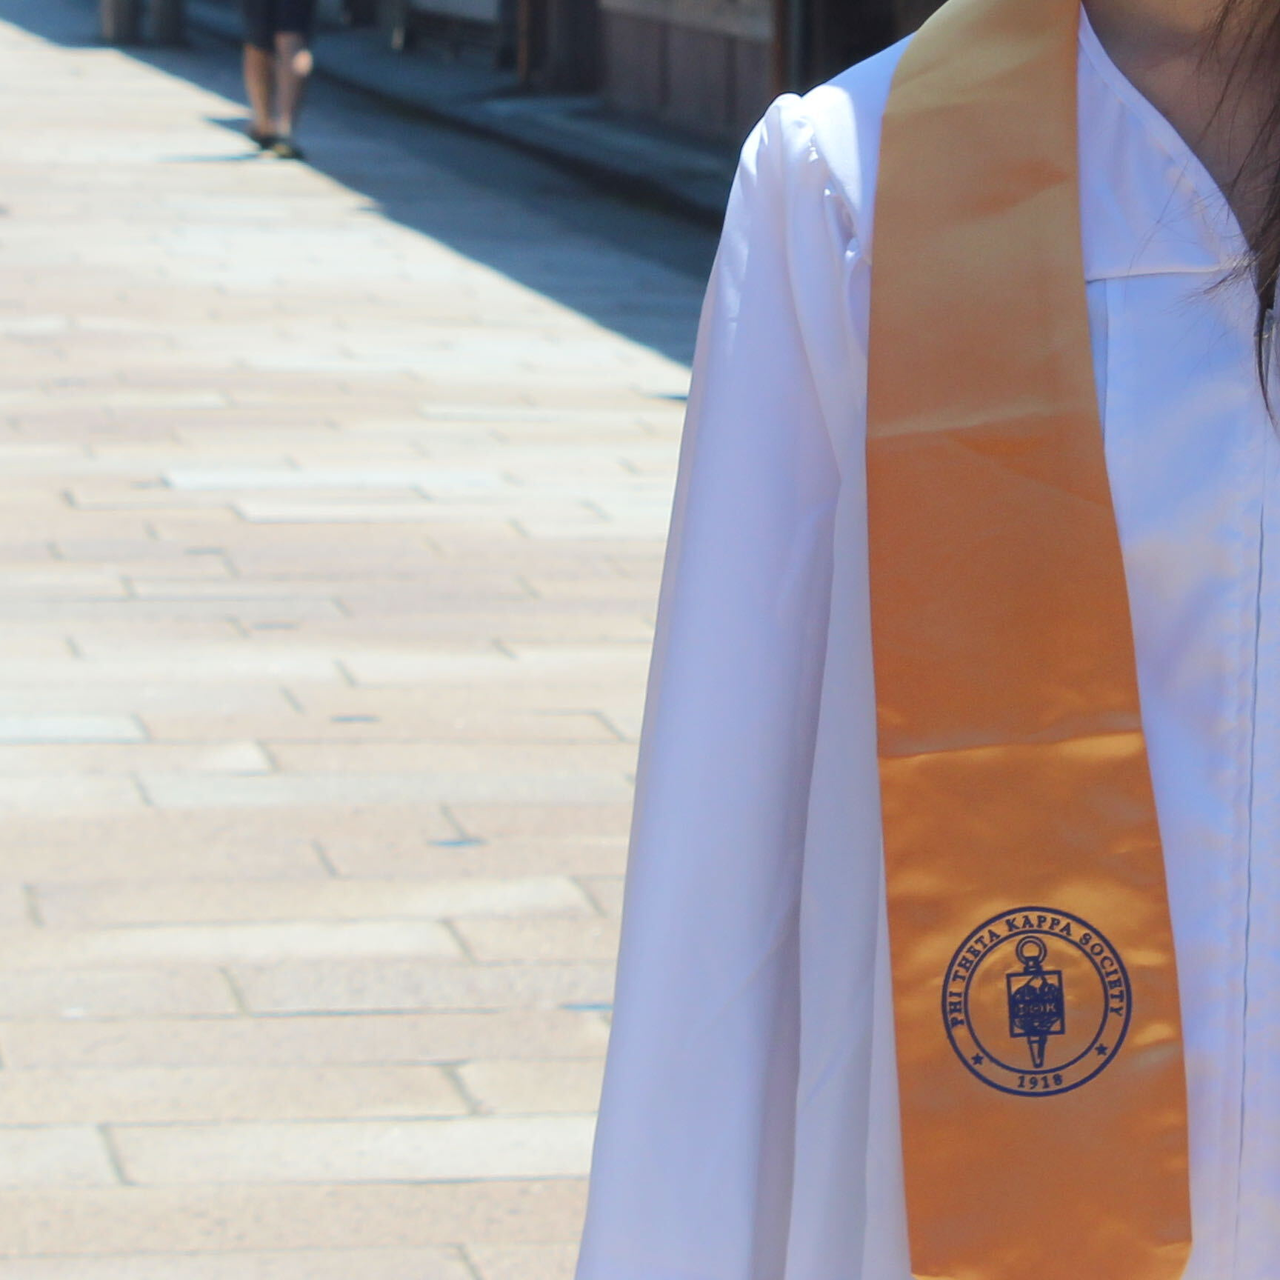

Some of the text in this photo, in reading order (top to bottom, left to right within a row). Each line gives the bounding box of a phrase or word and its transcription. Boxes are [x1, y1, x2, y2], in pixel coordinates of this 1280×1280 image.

[948, 915, 1125, 1028] PHI THETA KAPPA SOCIETY
[1017, 1073, 1063, 1090] 1918
